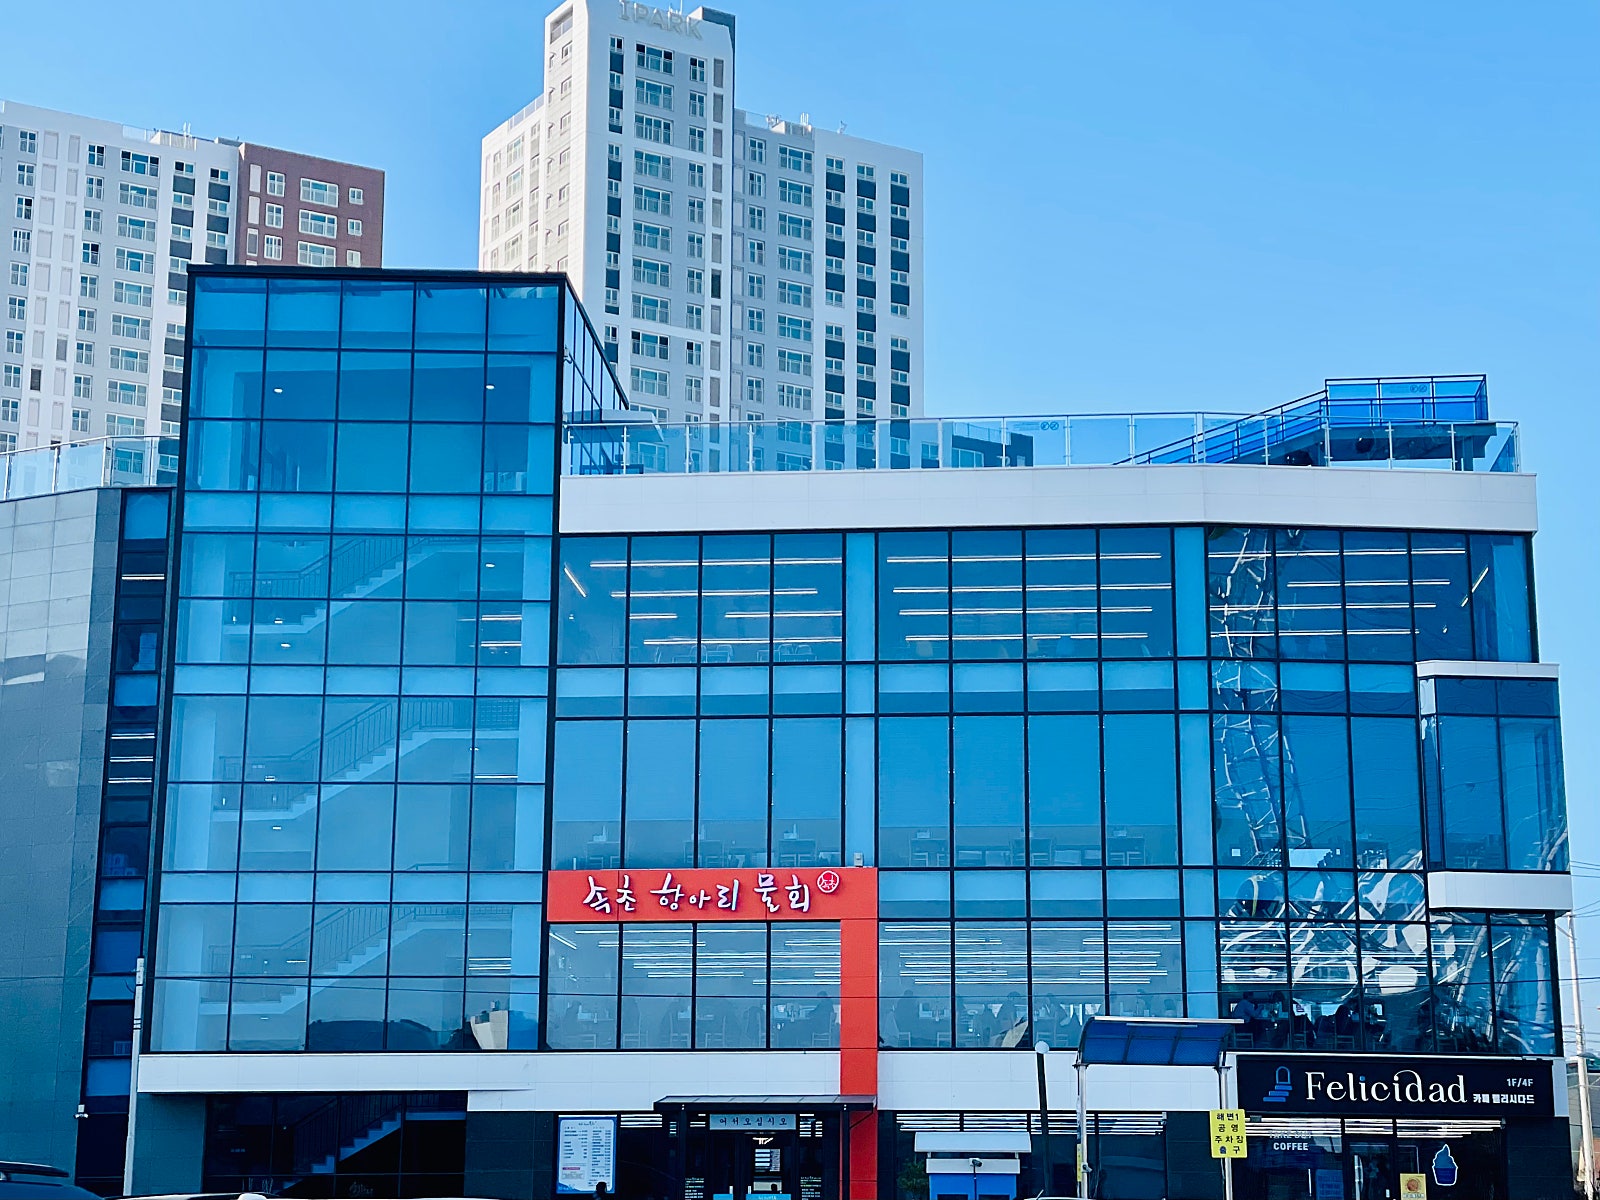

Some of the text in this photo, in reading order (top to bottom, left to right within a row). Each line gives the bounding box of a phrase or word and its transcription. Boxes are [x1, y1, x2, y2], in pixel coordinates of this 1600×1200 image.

[618, 0, 703, 40] IPARK
[582, 872, 810, 914] 속초 항아리 물회
[1304, 1069, 1468, 1104] Felicidad
[1506, 1077, 1534, 1088] 1F/4F
[1273, 1142, 1309, 1151] COFFEE
